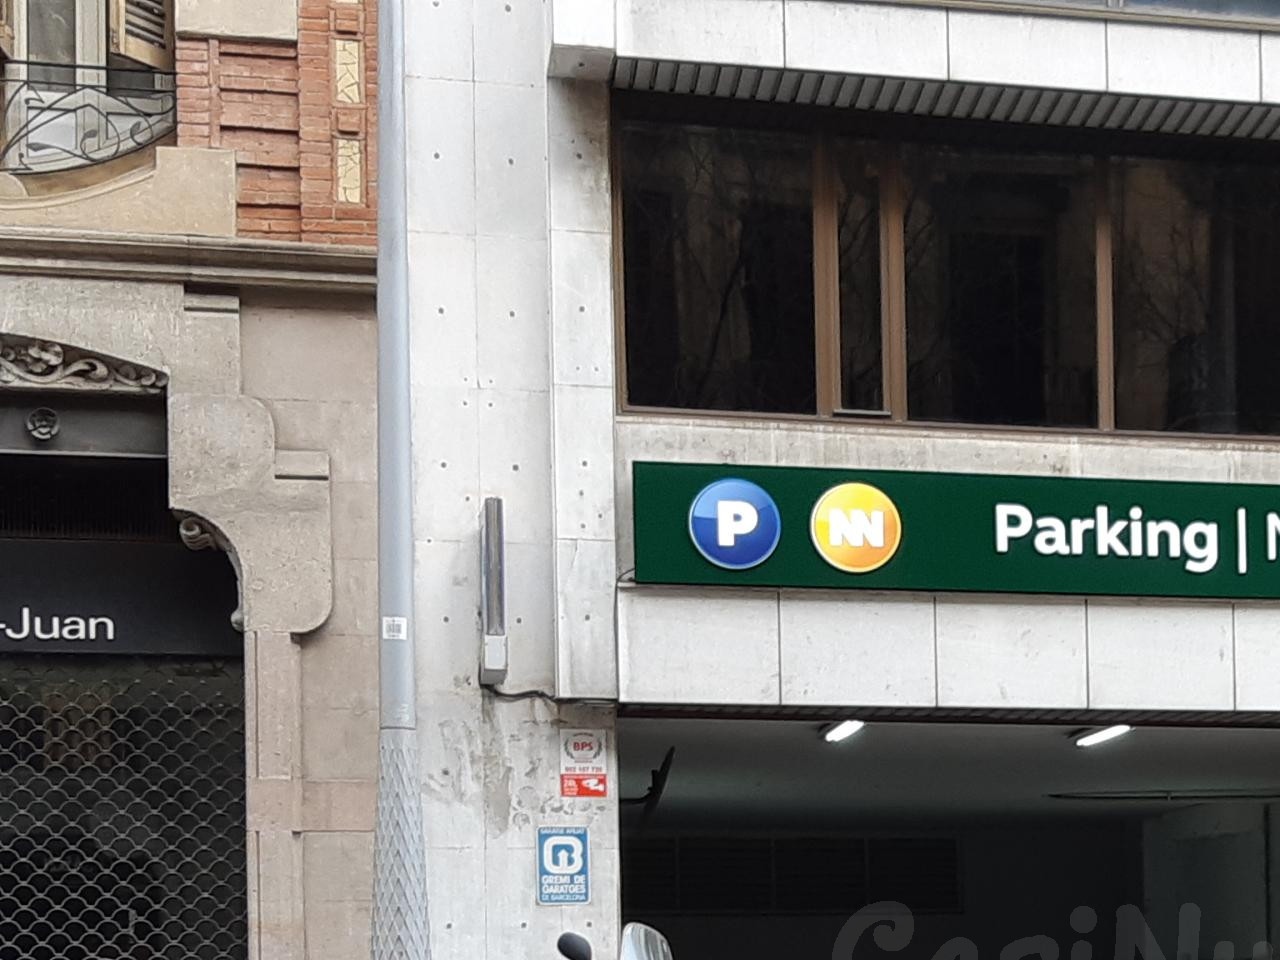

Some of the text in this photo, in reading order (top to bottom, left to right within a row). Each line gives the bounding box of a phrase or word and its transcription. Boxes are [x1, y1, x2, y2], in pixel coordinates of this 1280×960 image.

[716, 499, 759, 547] P
[828, 507, 886, 548] NN
[994, 502, 1219, 574] Parking
